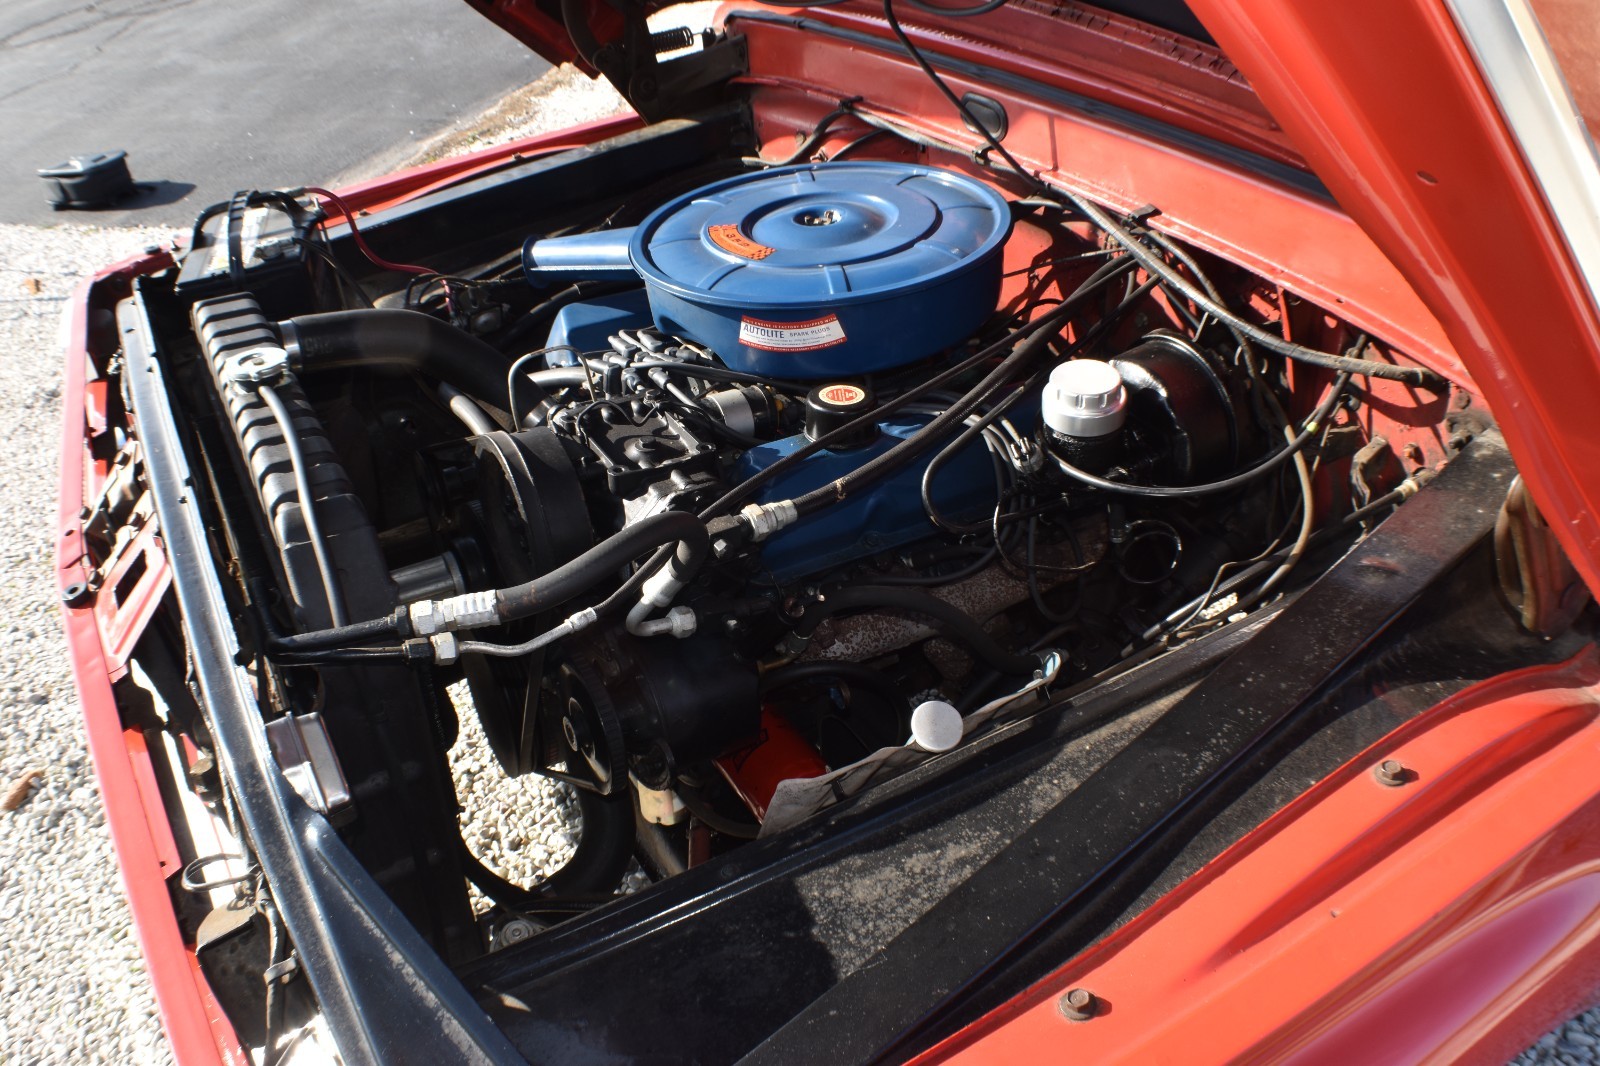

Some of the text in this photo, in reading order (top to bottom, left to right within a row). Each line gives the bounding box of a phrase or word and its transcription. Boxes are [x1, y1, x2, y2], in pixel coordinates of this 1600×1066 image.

[743, 323, 785, 338] AUTOLITE
[789, 329, 809, 338] SPARK
[811, 326, 831, 335] PLUGS
[800, 321, 824, 329] EQUIPPED
